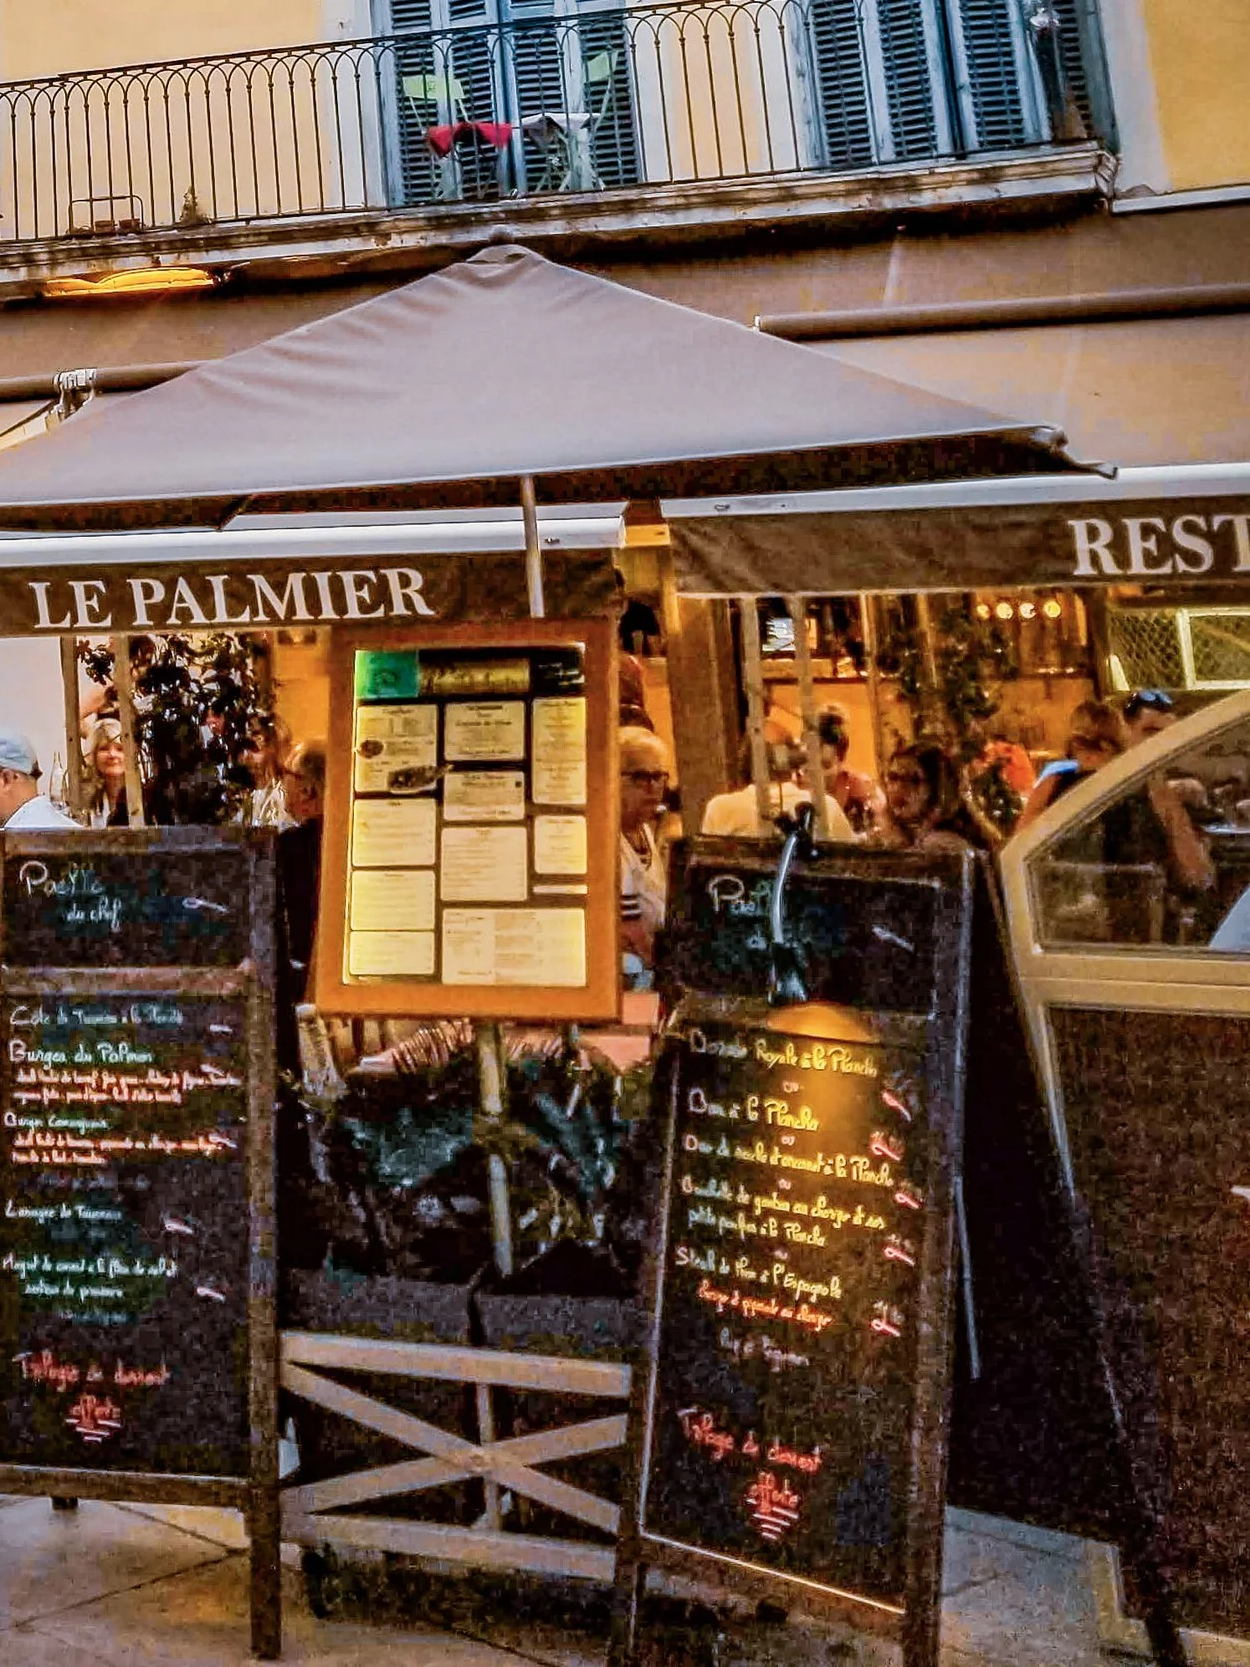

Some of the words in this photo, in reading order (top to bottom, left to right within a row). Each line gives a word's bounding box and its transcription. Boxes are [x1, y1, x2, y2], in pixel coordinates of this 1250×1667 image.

[1067, 514, 1250, 575] REST
[28, 580, 113, 629] LE
[126, 567, 434, 626] PALMIER
[755, 1039, 798, 1069] Royale
[764, 1100, 820, 1131] Plancha
[850, 1156, 894, 1187] Plancha
